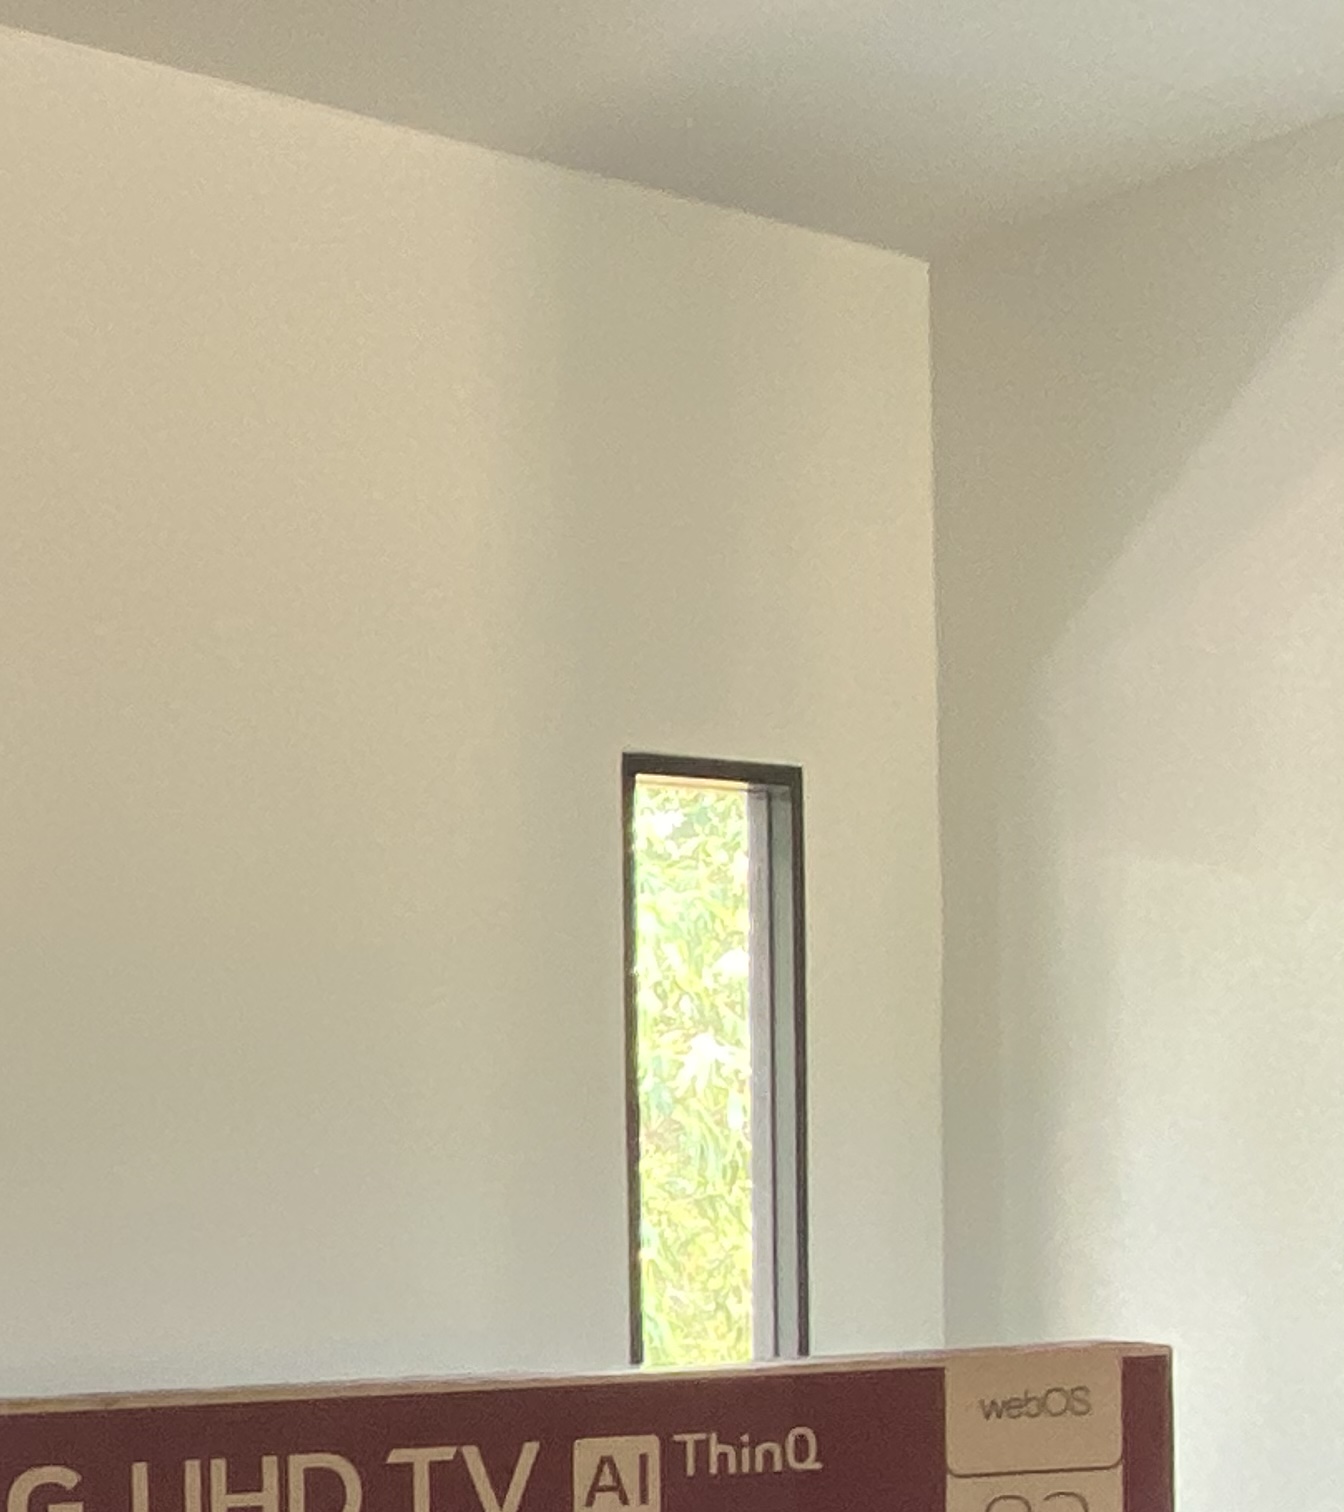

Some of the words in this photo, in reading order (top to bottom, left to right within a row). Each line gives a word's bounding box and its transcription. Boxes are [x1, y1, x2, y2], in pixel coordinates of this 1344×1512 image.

[979, 1386, 1092, 1421] webOS
[584, 1453, 651, 1509] AI
[673, 1427, 823, 1479] ThinQ
